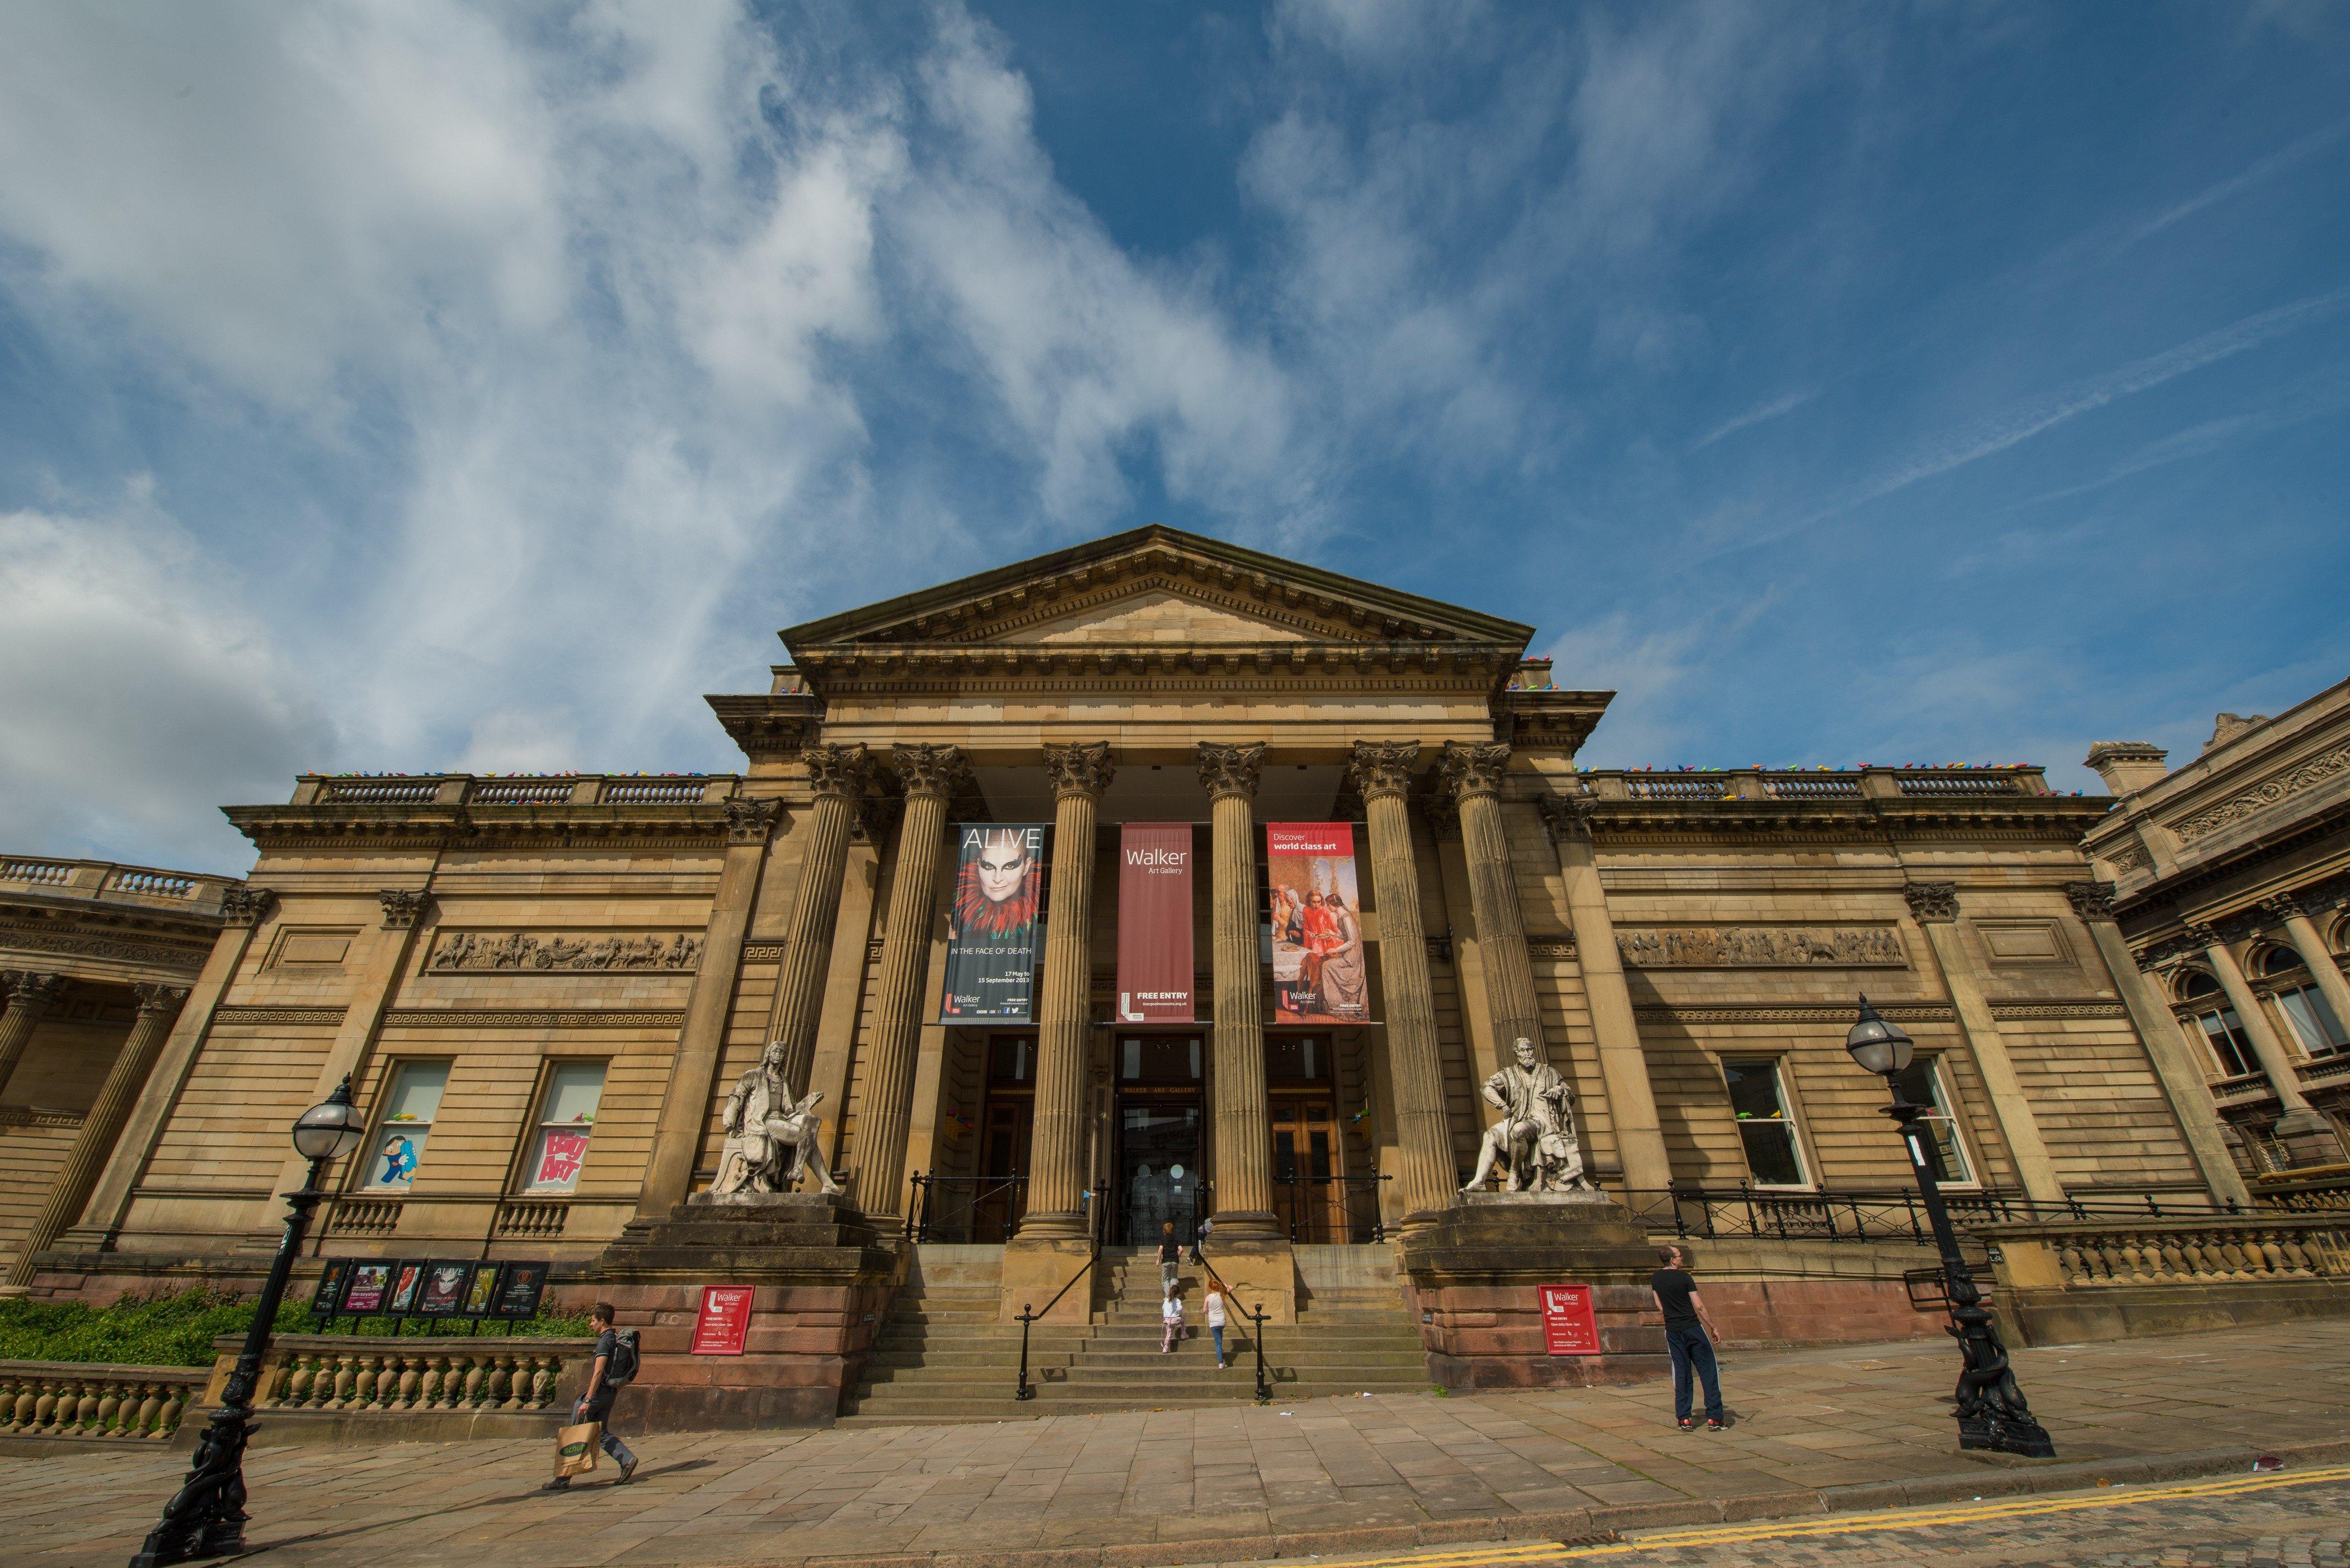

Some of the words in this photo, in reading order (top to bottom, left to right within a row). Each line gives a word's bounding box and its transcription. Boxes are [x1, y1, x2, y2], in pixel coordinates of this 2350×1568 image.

[963, 828, 1041, 849] ALIVE
[1126, 849, 1187, 865] Walker
[954, 995, 981, 1003] Walker
[1290, 991, 1317, 1000] Walker
[546, 1130, 589, 1161] Big
[538, 1155, 581, 1182] ART
[434, 1267, 464, 1275] ALIVE
[717, 1293, 742, 1302] Walker
[1554, 1292, 1578, 1301] Walker
